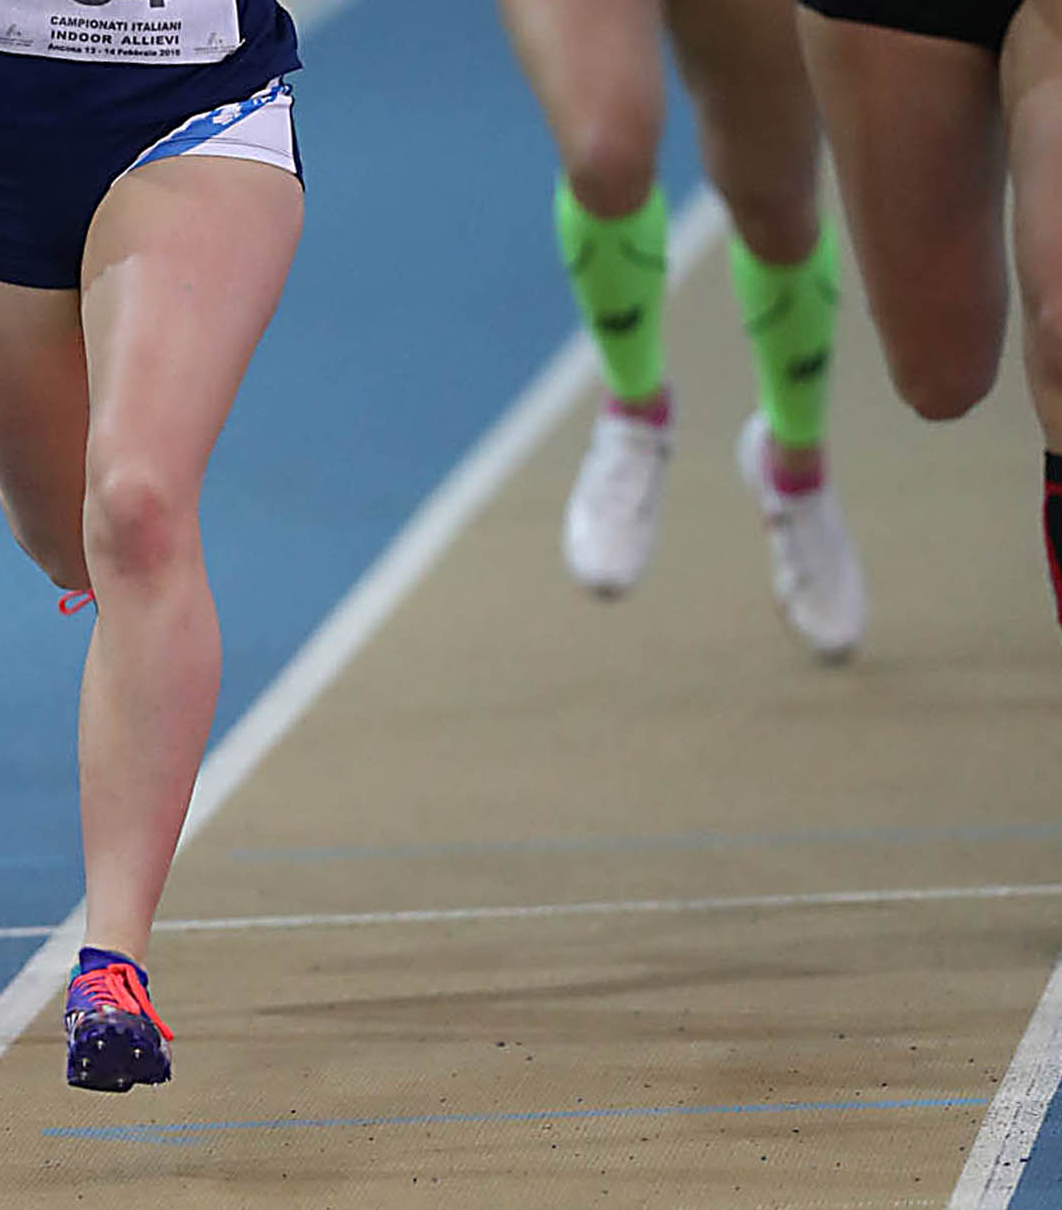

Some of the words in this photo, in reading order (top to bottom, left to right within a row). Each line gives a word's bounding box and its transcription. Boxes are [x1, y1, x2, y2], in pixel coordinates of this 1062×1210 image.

[50, 16, 128, 31] CAMPIONATI
[131, 21, 182, 32] ITALIANI
[50, 30, 112, 45] INDOOR
[121, 35, 179, 46] ALLIEVI
